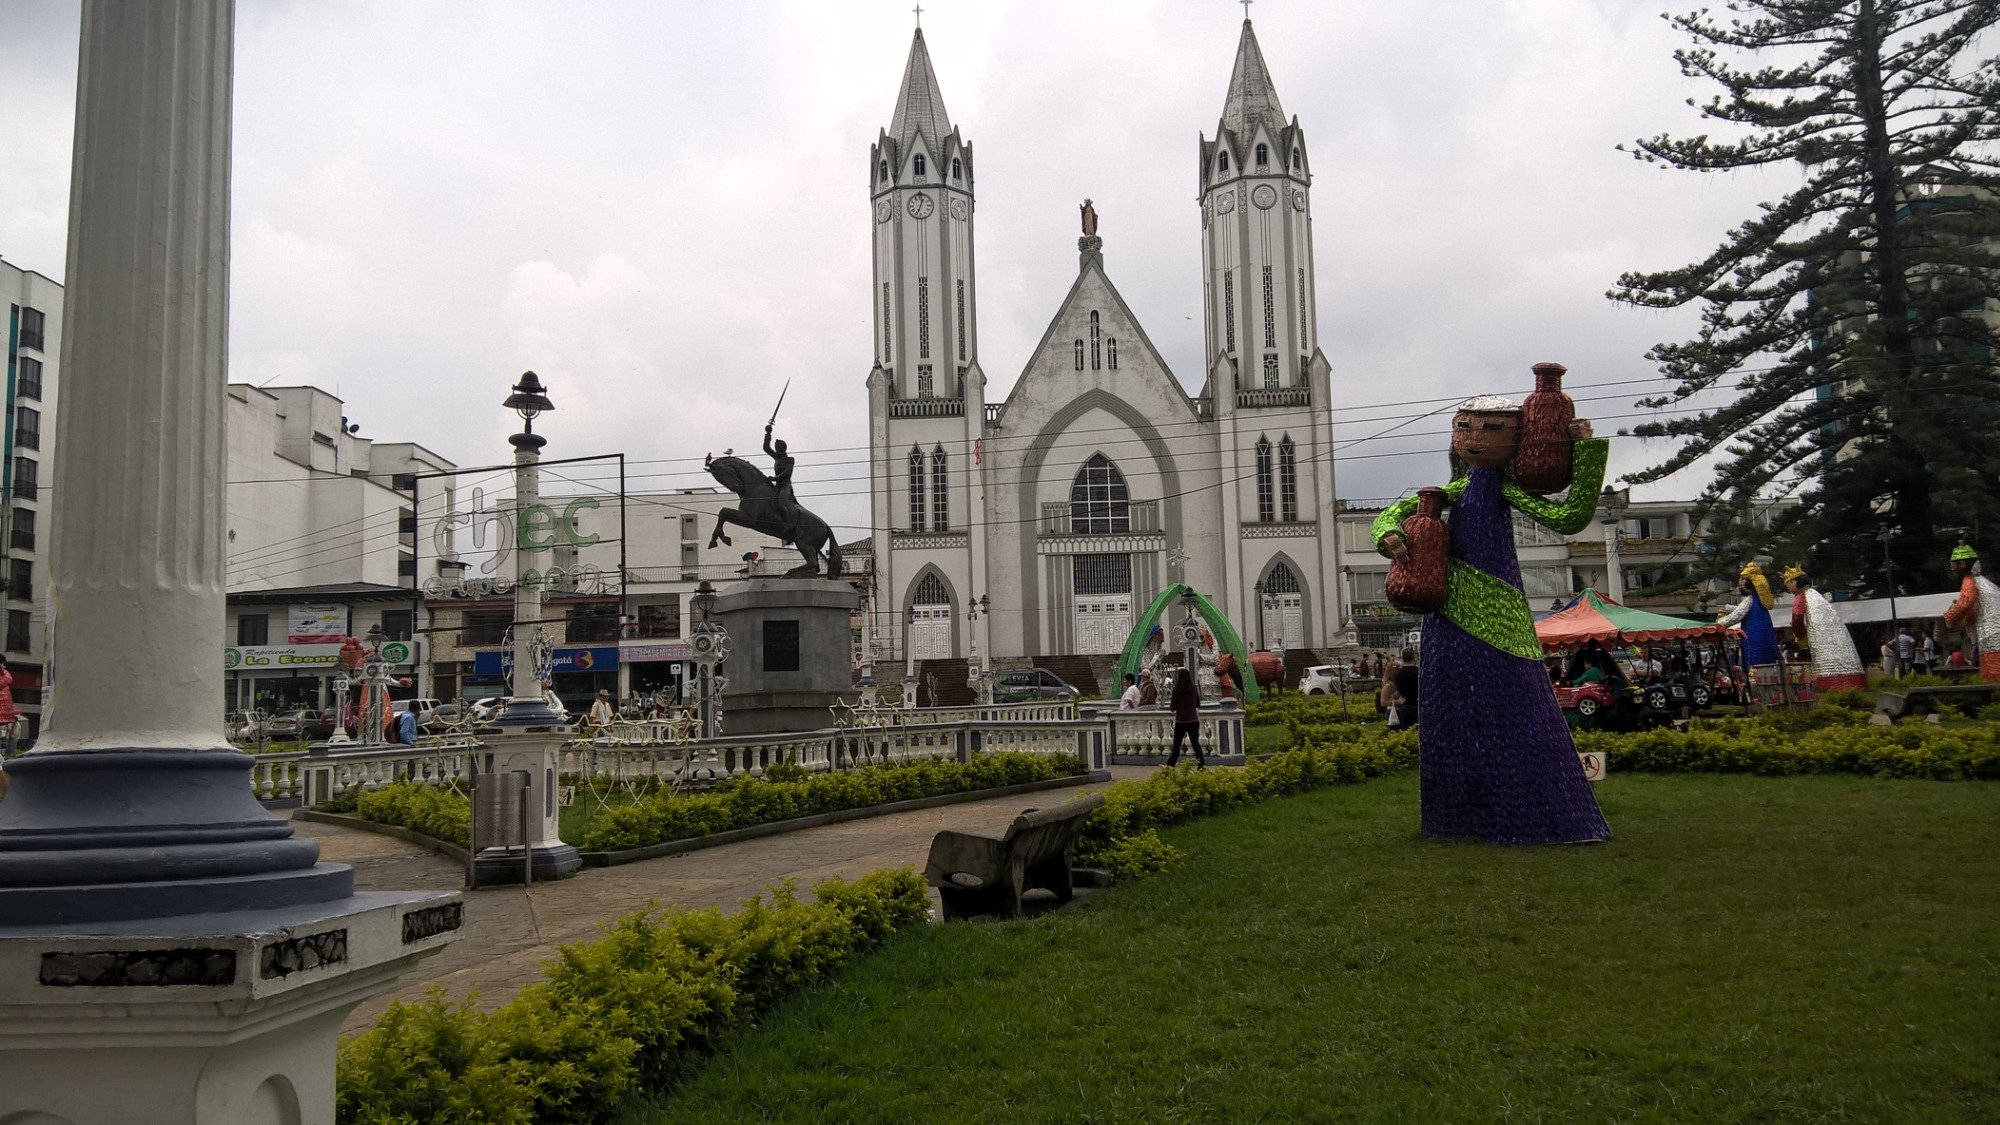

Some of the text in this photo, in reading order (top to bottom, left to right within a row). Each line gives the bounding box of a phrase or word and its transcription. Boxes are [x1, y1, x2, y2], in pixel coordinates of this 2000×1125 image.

[433, 487, 600, 574] chec
[521, 564, 603, 602] epm
[245, 648, 296, 656] Rapitienda
[638, 648, 672, 659] ACADEMIA
[245, 656, 270, 666] La
